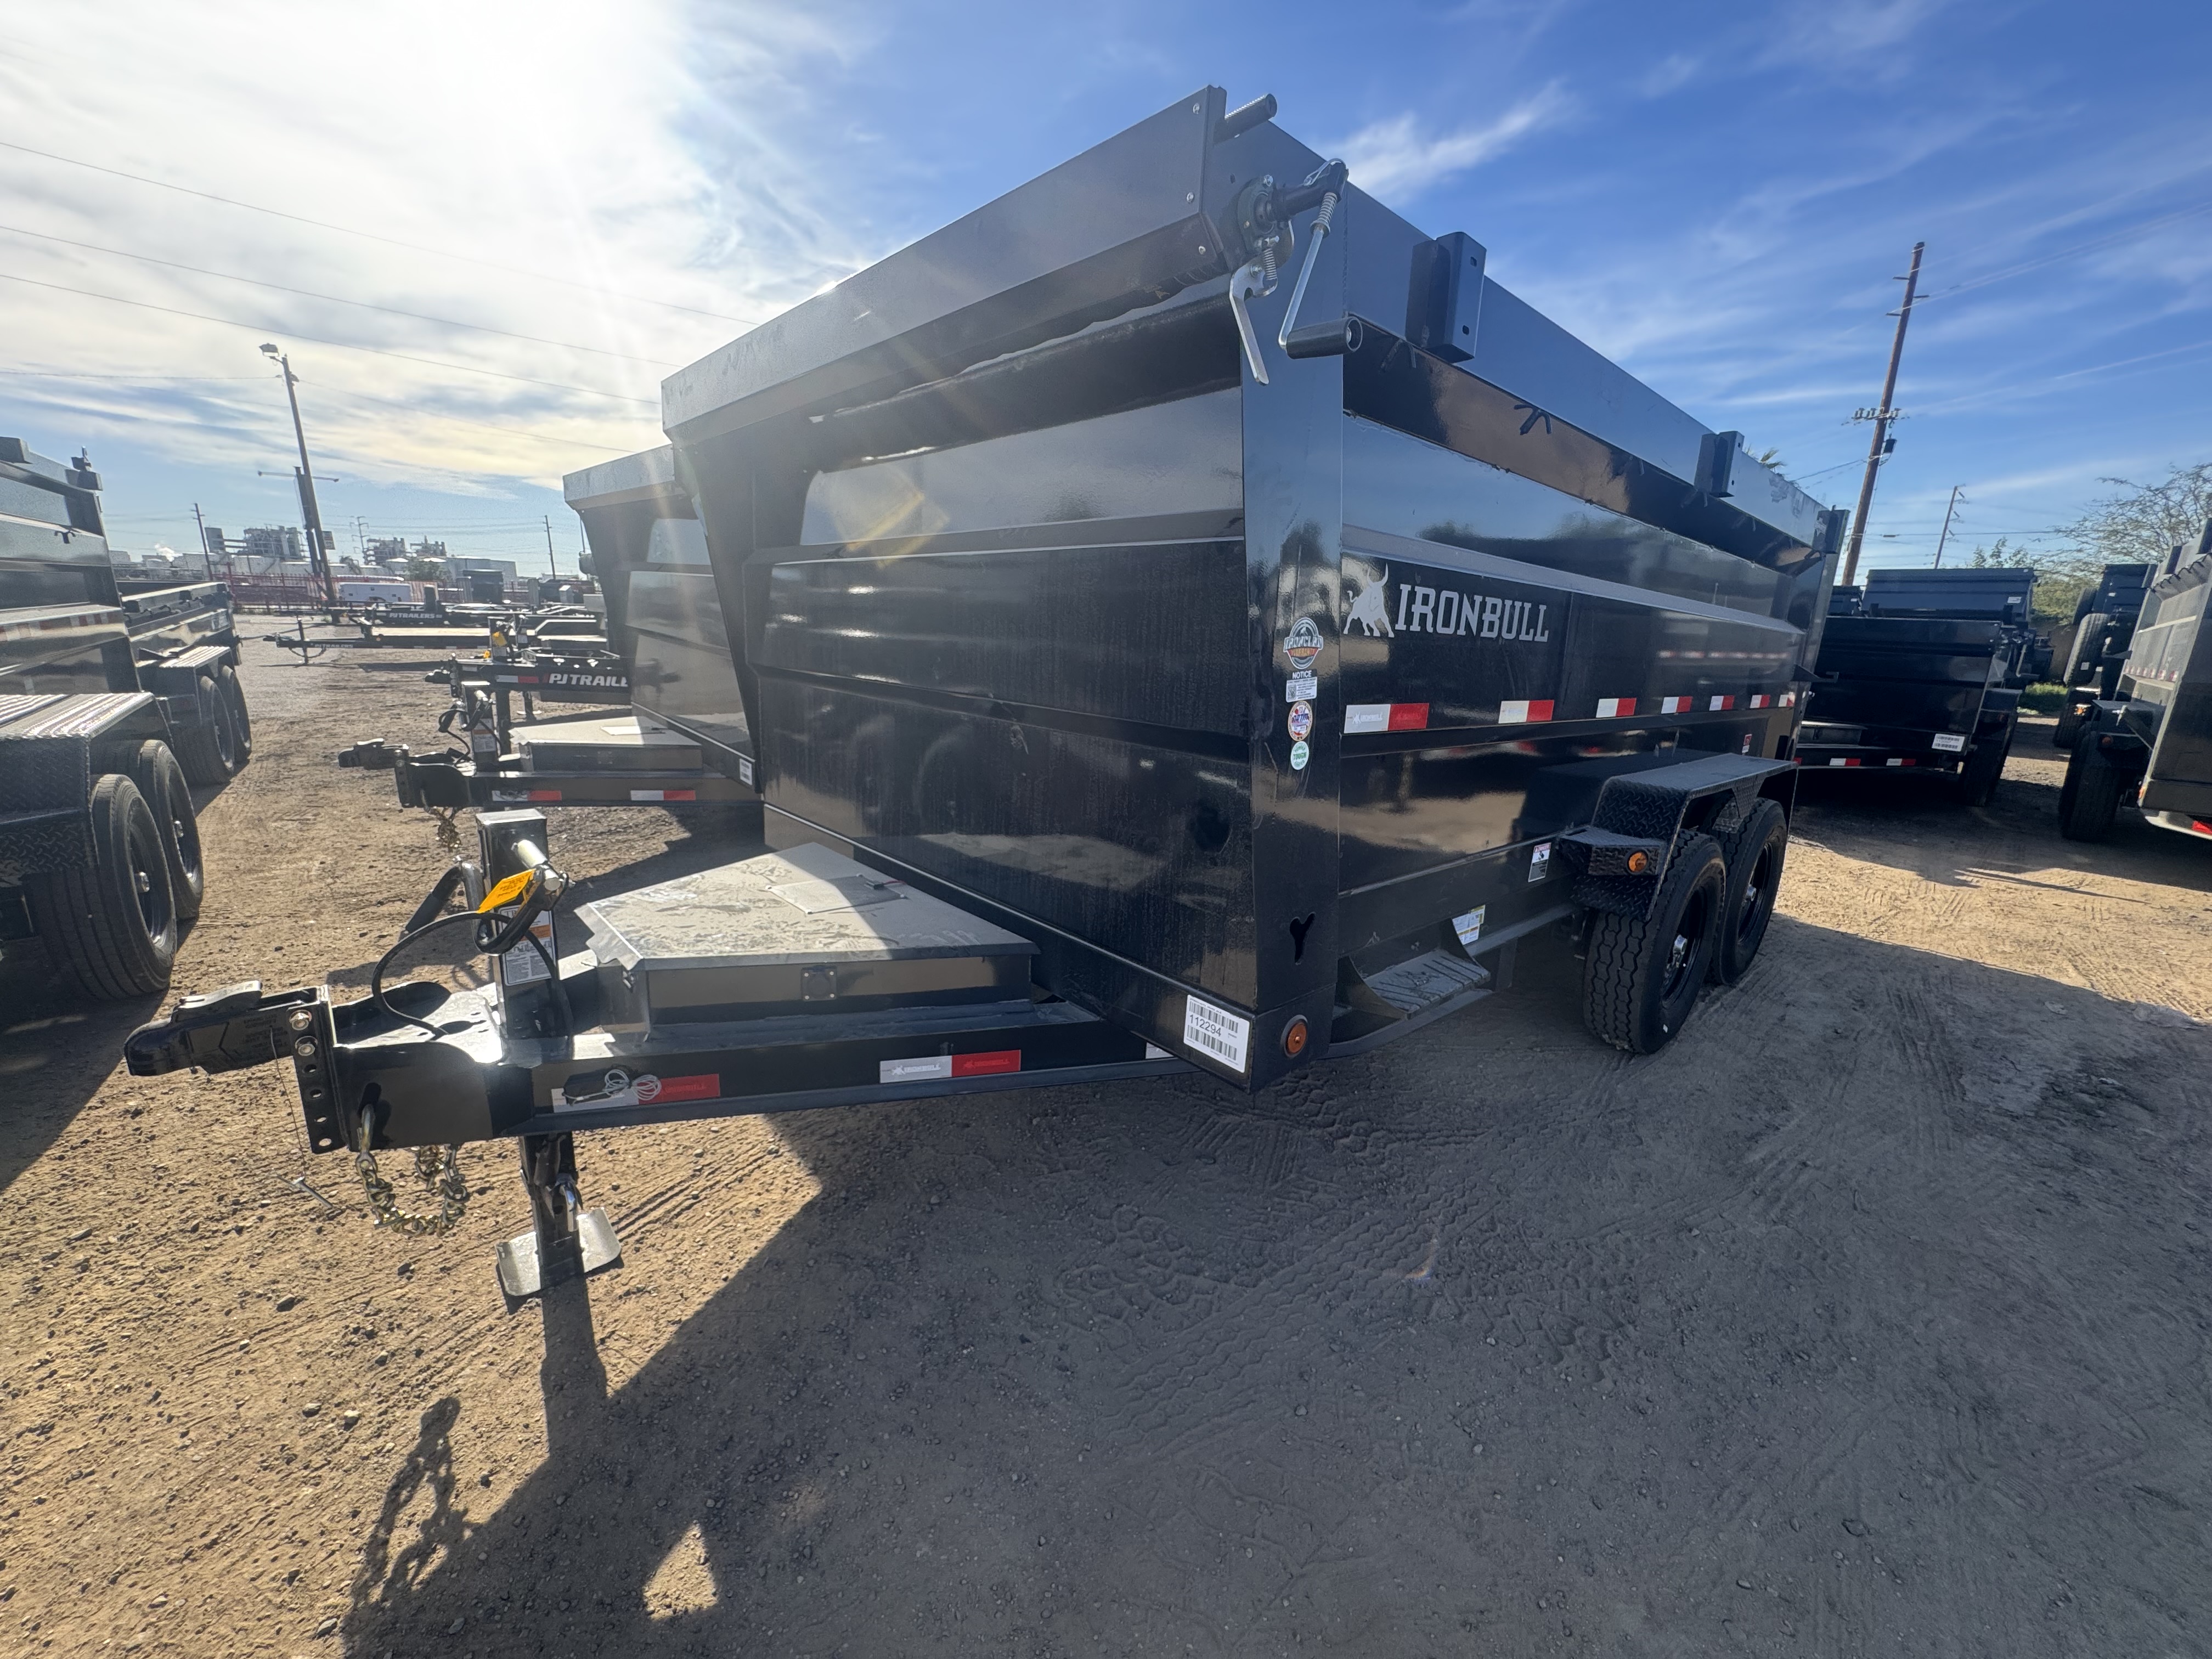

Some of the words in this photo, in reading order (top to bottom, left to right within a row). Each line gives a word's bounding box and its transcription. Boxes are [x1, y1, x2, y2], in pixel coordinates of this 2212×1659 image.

[1395, 584, 1548, 642] IRONBULL
[1293, 670, 1312, 679] NOTICE
[1189, 1014, 1221, 1036] 112294
